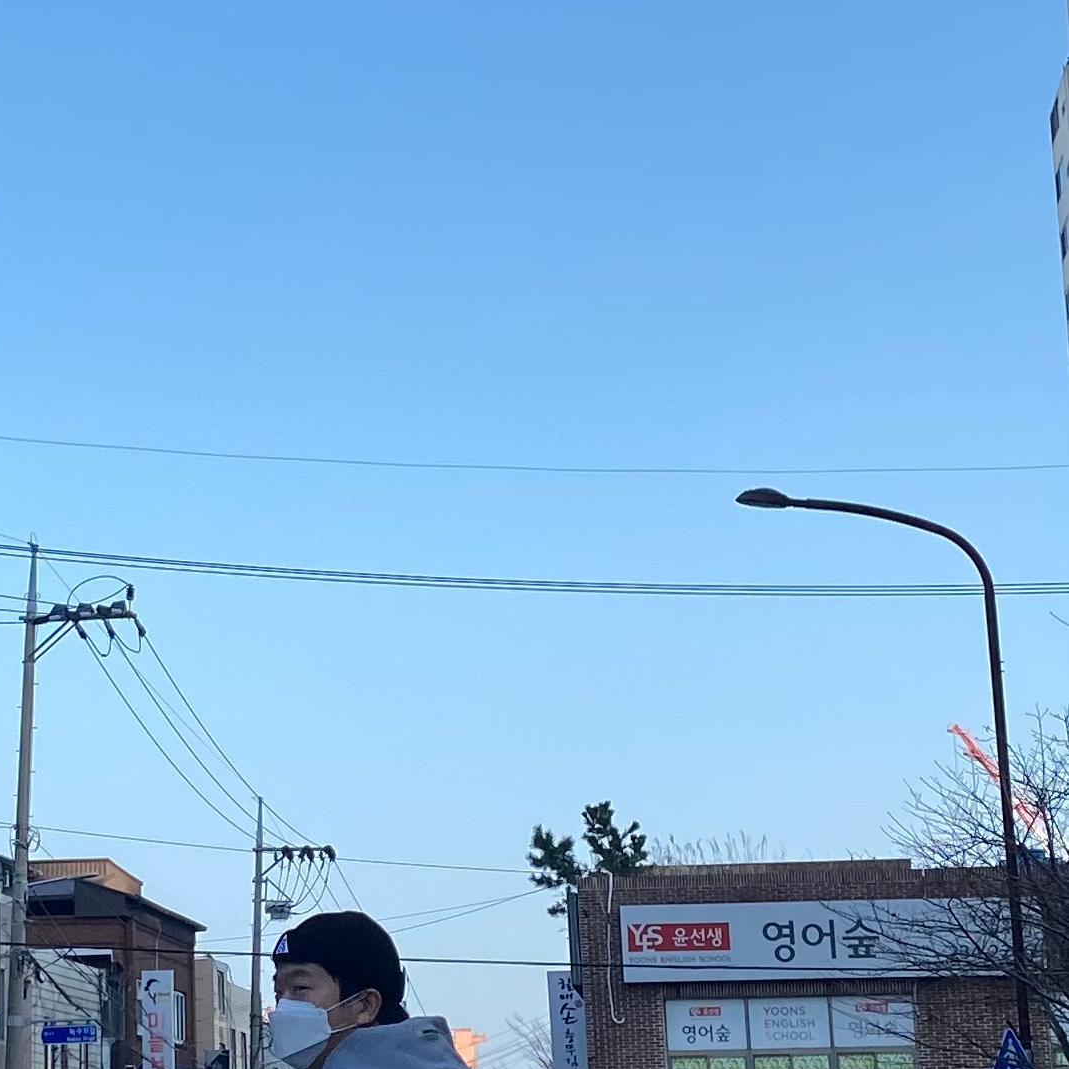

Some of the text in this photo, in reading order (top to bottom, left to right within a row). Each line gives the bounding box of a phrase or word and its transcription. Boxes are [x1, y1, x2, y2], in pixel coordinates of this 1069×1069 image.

[672, 926, 724, 948] 윤선생
[762, 918, 880, 963] 영어숲
[629, 955, 733, 964] YOONS ENGLISH SCHOOL
[763, 1006, 806, 1016] YOONS
[764, 1019, 816, 1029] ENGLISH
[682, 1024, 731, 1044] 영어숲
[765, 1031, 815, 1041] SCHOOL
